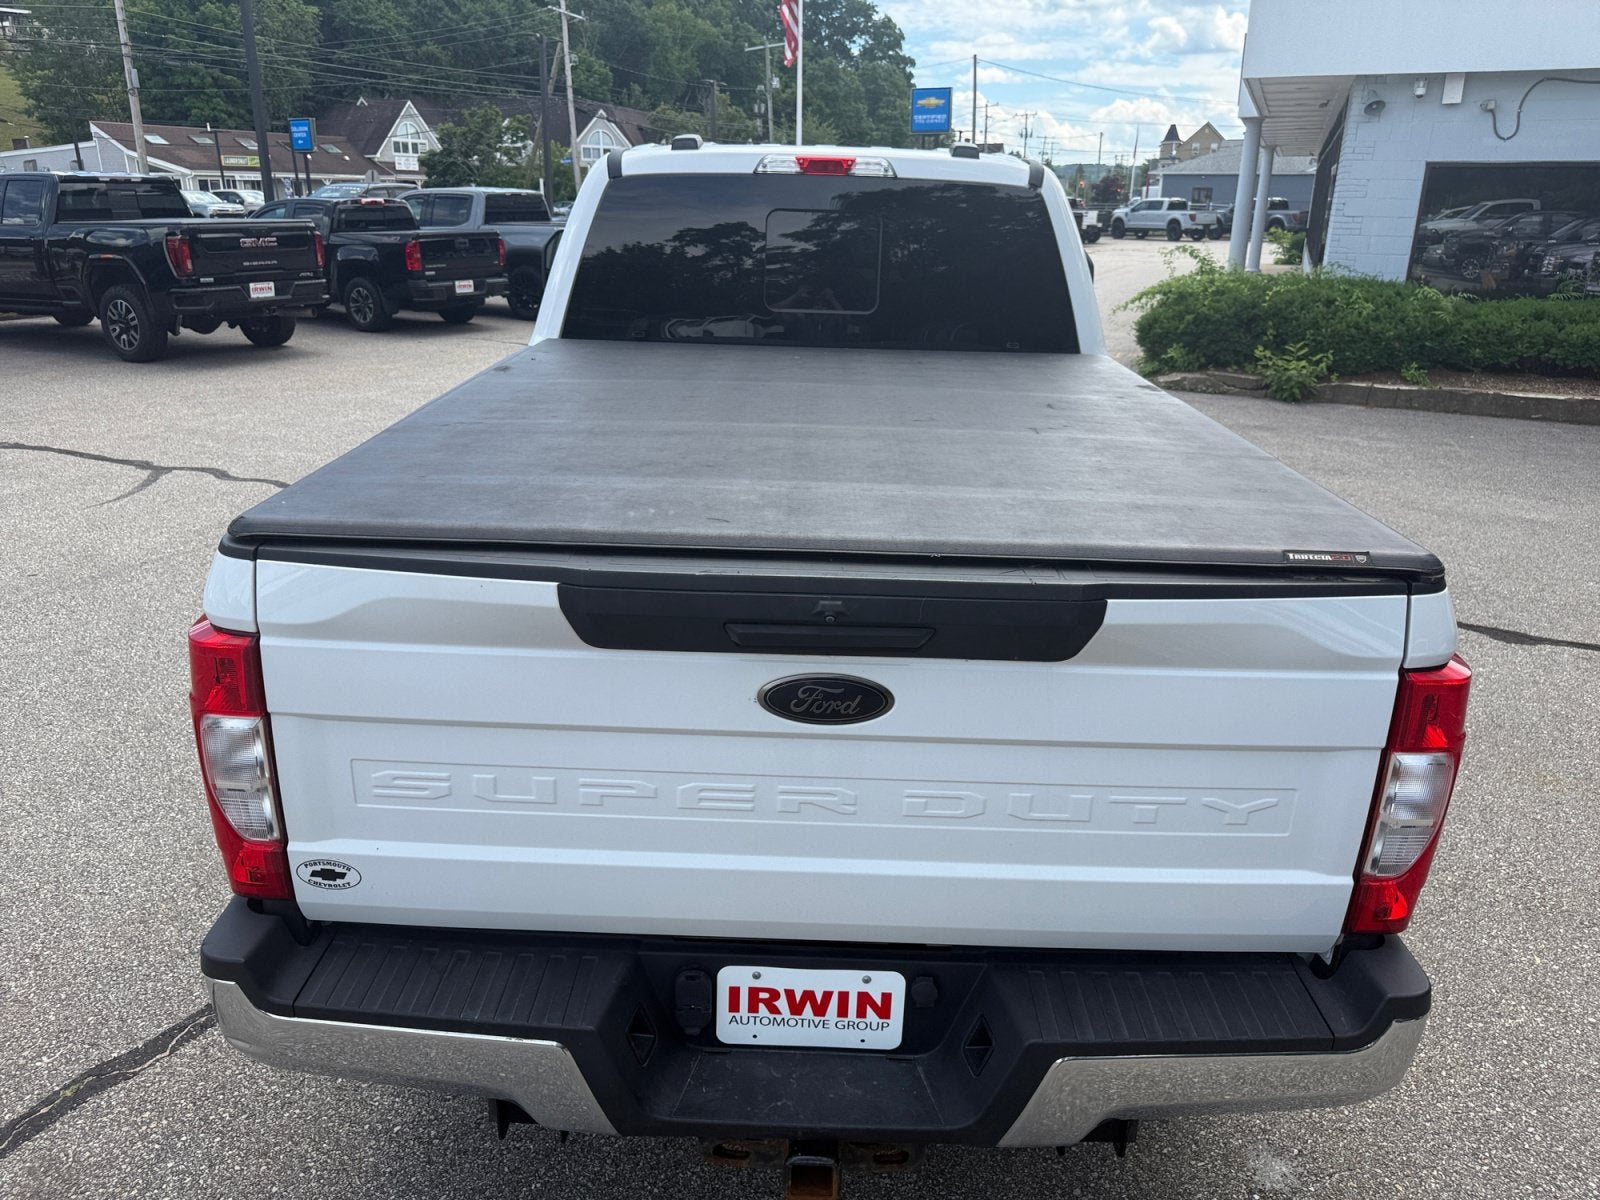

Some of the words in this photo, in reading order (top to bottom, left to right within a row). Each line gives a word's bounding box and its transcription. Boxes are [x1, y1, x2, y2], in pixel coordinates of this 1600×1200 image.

[240, 237, 278, 247] GMC
[790, 685, 863, 715] Ford
[371, 770, 857, 816] SUPER
[902, 789, 1280, 826] DUTY
[303, 861, 352, 872] PORTSMOUTH
[307, 879, 351, 888] CHEVROLET
[728, 986, 893, 1020] IRWIN
[728, 1015, 830, 1030] AUTOMOTIVE
[834, 1020, 890, 1031] GROUP
